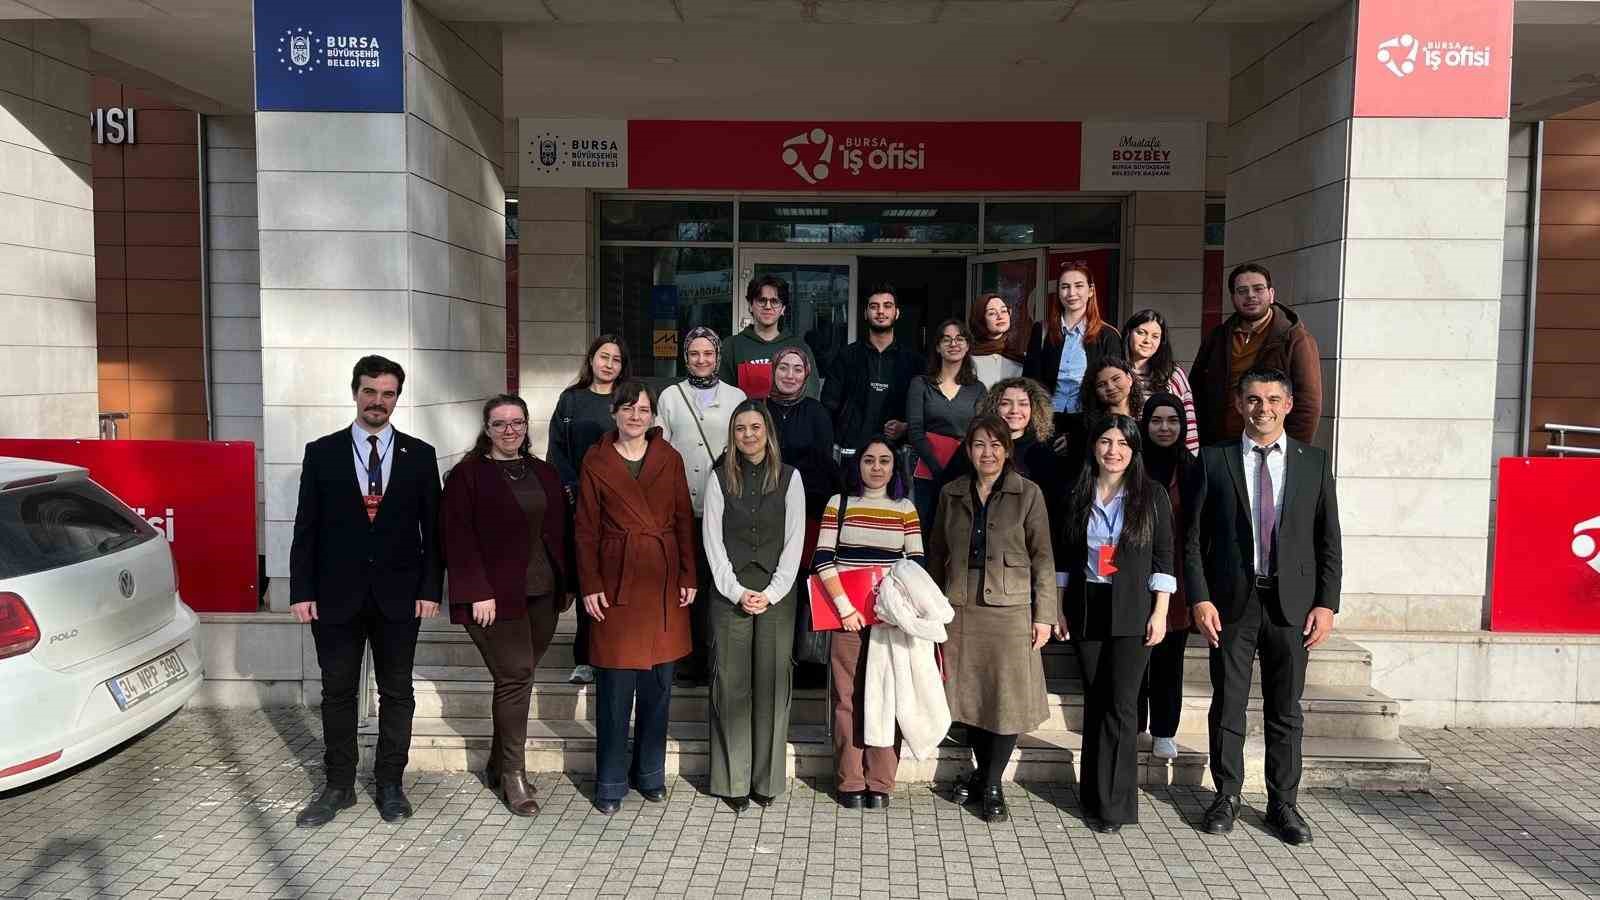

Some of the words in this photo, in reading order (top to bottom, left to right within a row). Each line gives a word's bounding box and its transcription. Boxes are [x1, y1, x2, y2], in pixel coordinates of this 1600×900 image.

[327, 36, 379, 48] BURSA
[327, 48, 379, 58] BÜYÜKŞEHİR
[1445, 46, 1490, 67] ofisi
[327, 58, 380, 68] BELEDİYESİ
[90, 107, 134, 143] ISI
[572, 140, 617, 150] BURSA
[846, 137, 888, 147] BURSA
[838, 144, 864, 175] iş
[868, 142, 925, 170] ofisi
[1113, 150, 1170, 161] BOZBEY
[50, 629, 79, 644] POLO
[120, 678, 138, 698] 34
[137, 665, 159, 690] NPP
[160, 655, 182, 678] 390
